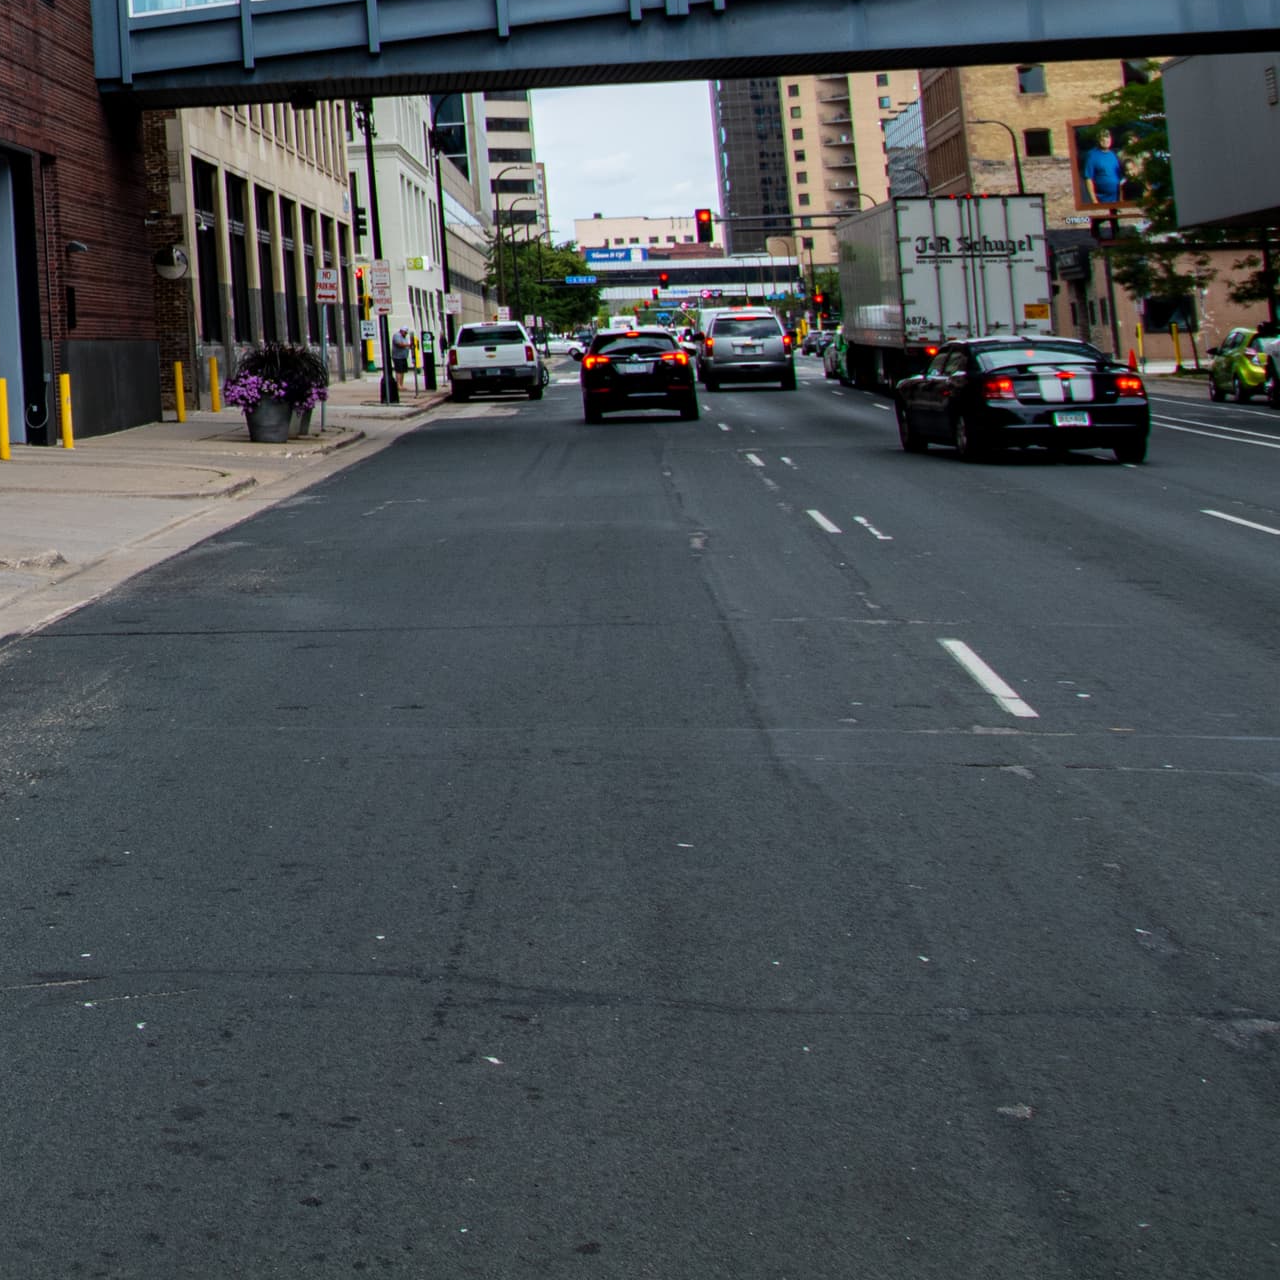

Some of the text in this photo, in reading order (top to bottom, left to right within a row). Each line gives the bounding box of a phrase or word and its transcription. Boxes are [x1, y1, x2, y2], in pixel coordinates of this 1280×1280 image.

[957, 234, 1033, 256] Schugel
[322, 271, 331, 280] NO
[315, 282, 336, 290] PARKING
